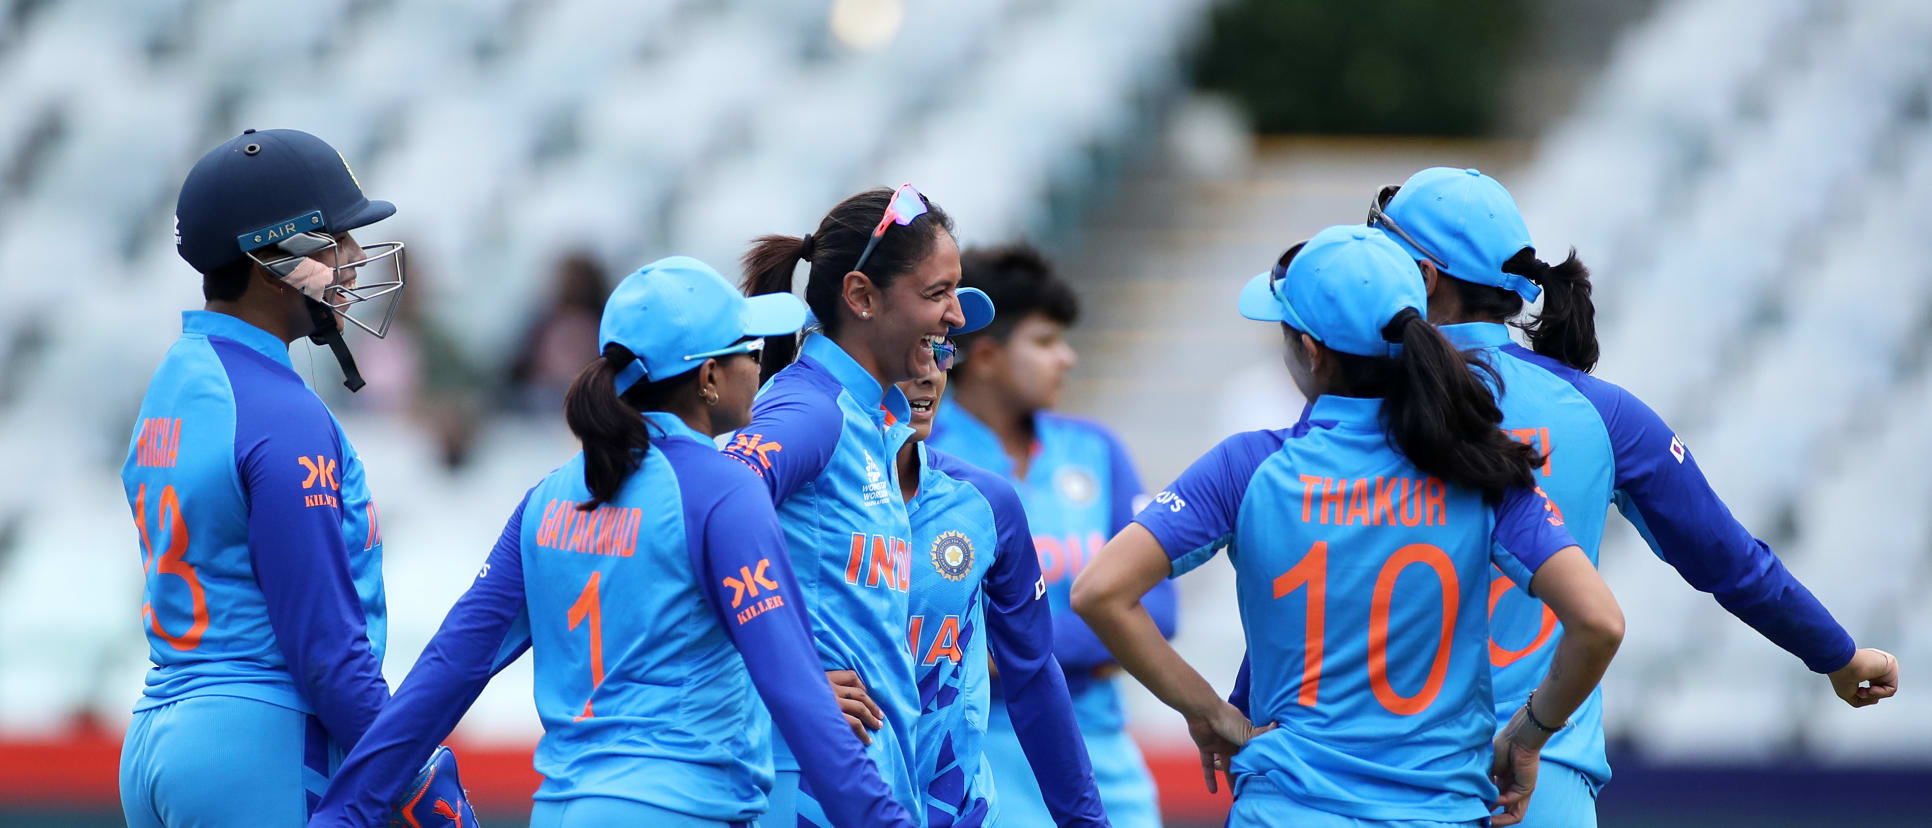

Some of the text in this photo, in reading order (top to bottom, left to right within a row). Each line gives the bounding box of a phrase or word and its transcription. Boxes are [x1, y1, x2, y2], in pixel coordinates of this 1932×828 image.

[268, 222, 296, 240] AIR
[137, 418, 182, 468] RICHA
[537, 498, 642, 557] GAYAKWAD
[1299, 474, 1446, 527] THAKUR
[136, 483, 209, 651] 13
[736, 595, 784, 625] KILLER
[1273, 541, 1460, 716] 10
[567, 571, 605, 722] 1
